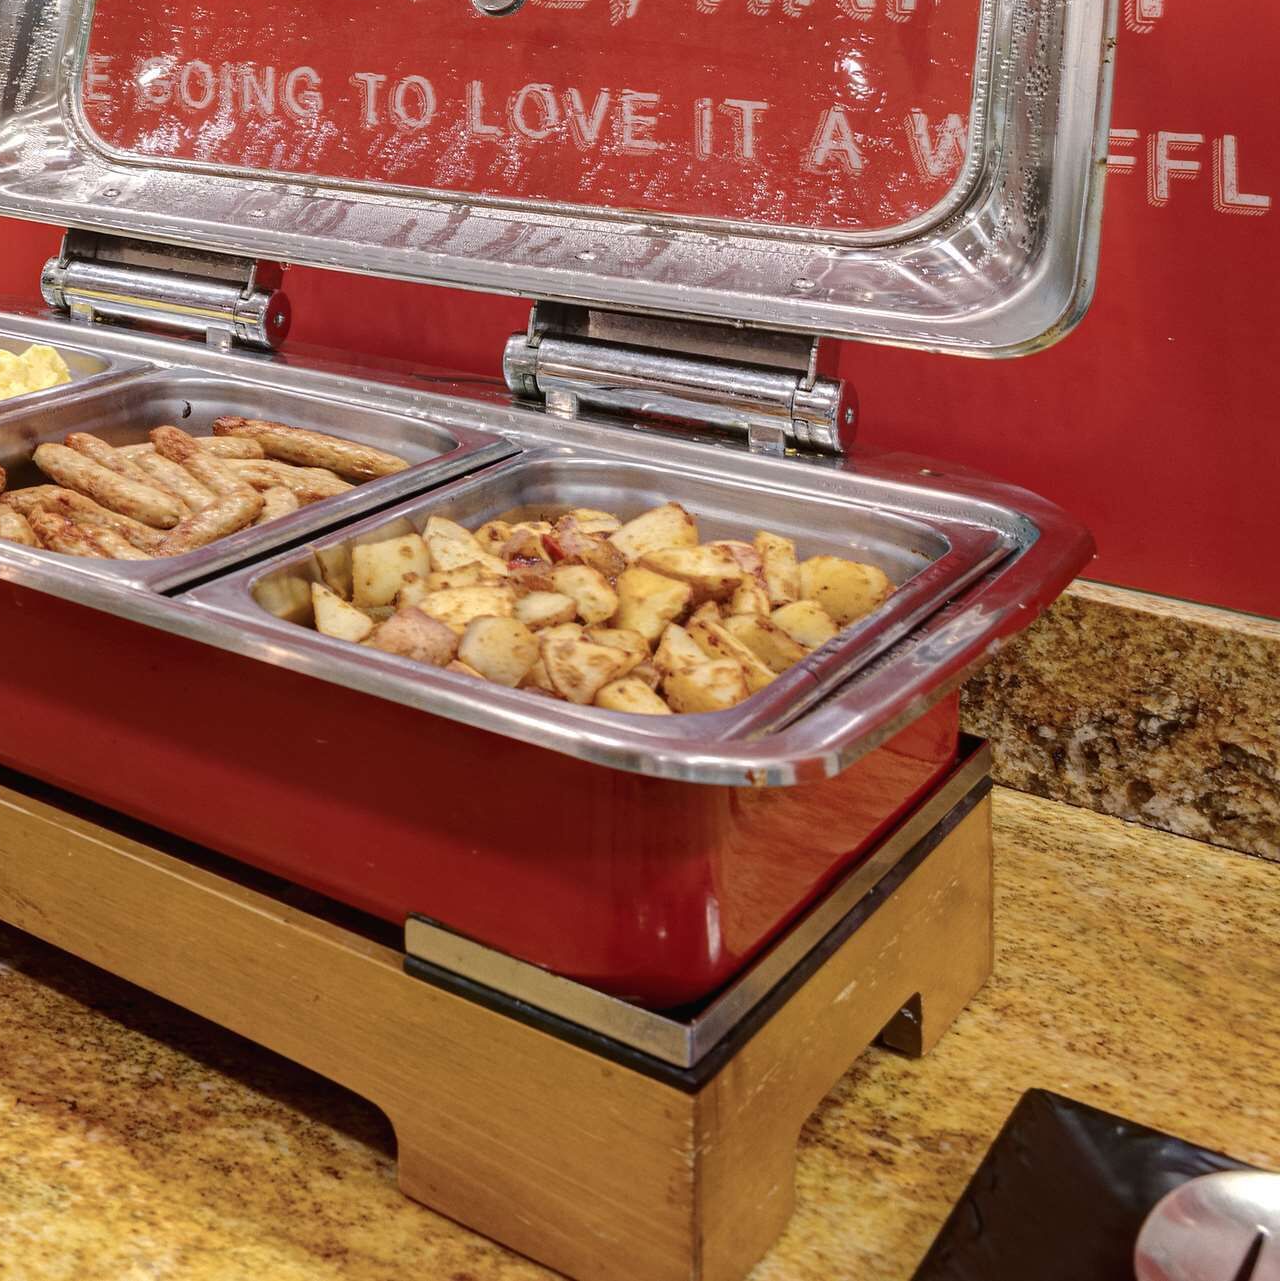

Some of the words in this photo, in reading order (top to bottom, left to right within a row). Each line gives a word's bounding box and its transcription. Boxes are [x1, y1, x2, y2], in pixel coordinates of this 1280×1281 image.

[135, 55, 323, 119] GOING
[351, 72, 437, 131] TO
[468, 79, 662, 154] LOVE
[695, 97, 769, 162] IT
[803, 105, 864, 177] A
[904, 108, 1271, 216] WFL
